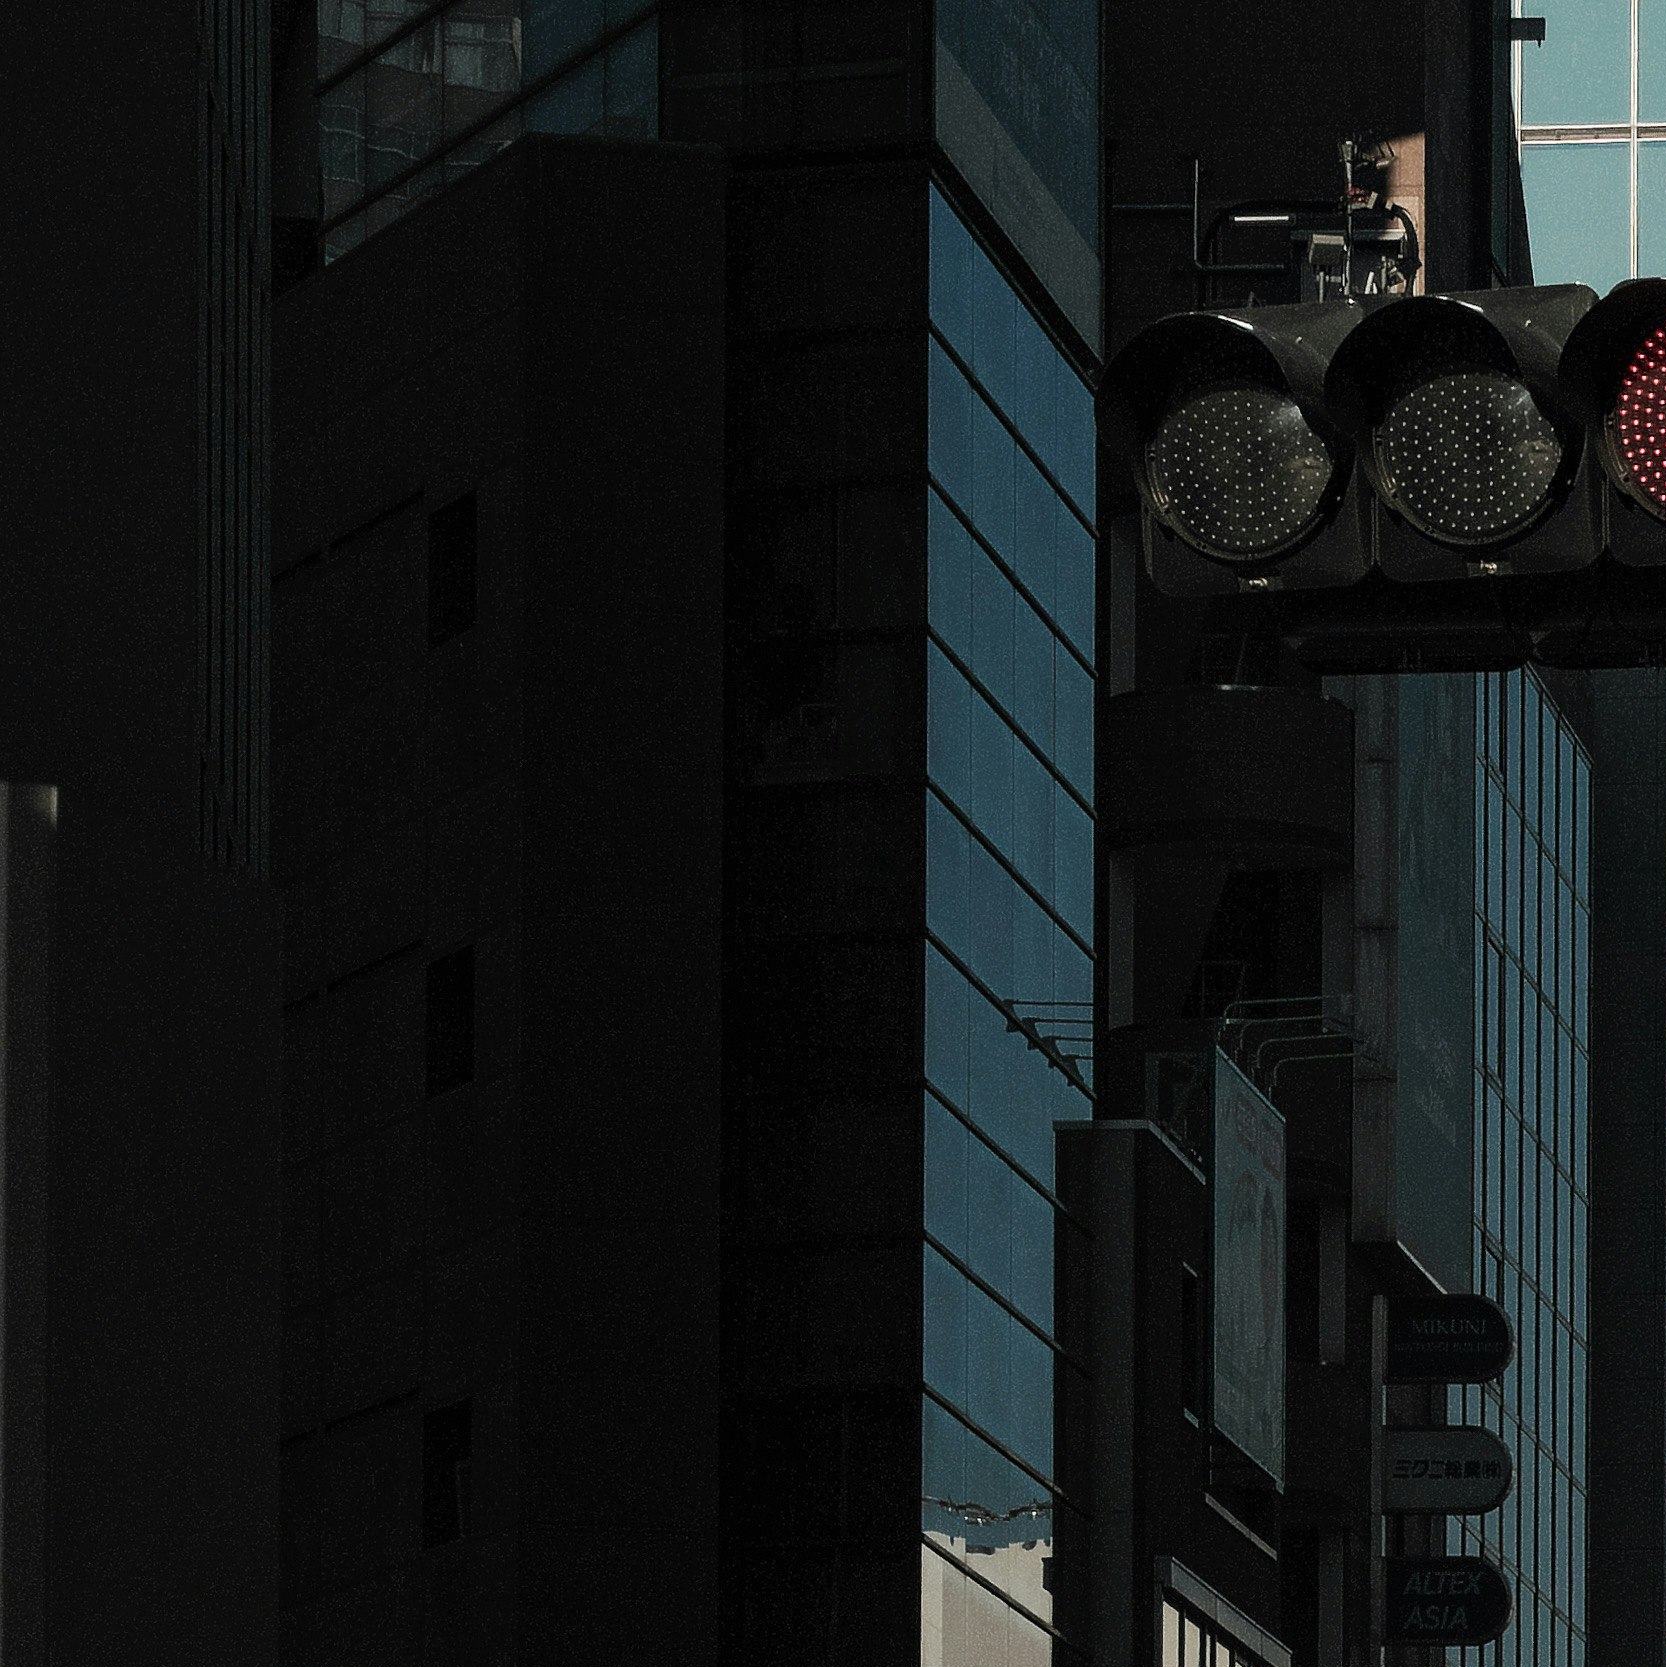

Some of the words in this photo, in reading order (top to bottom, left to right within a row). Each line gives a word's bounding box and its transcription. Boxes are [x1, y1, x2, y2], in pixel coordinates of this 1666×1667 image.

[1410, 1319, 1488, 1334] MIKUNI
[1403, 1571, 1484, 1596] ALTEX
[1403, 1605, 1468, 1630] ASIA
